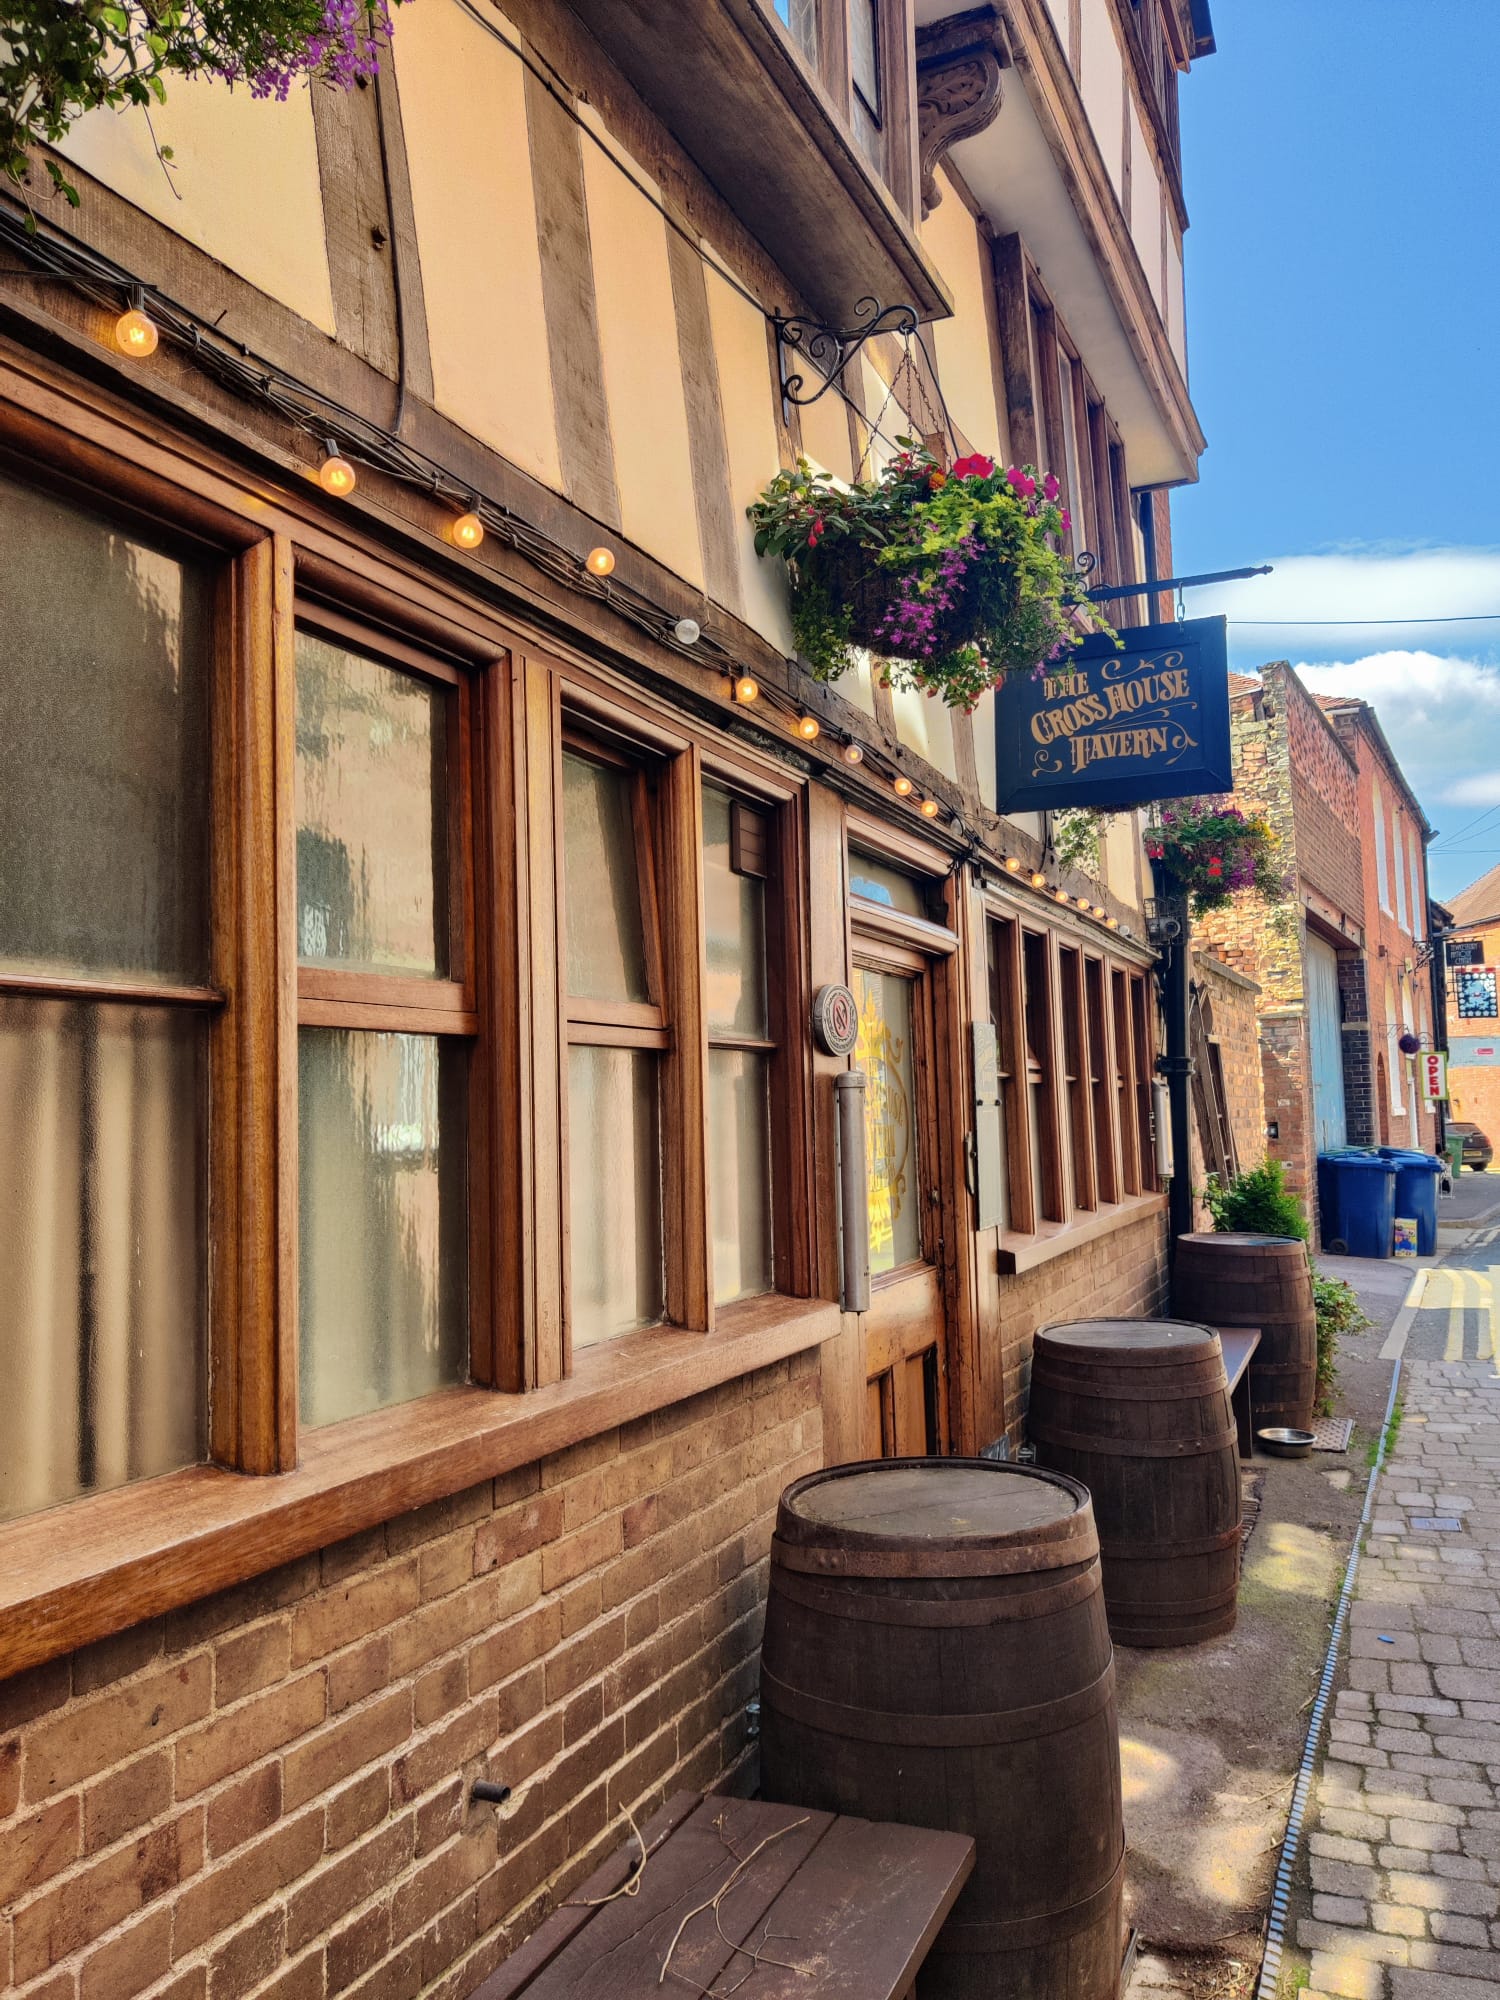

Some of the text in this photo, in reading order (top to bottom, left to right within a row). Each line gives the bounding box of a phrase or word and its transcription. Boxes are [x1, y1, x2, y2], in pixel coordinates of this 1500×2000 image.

[1031, 669, 1190, 745] CROSS HOUSE
[1043, 672, 1089, 701] THE
[1069, 727, 1168, 774] TAVERN
[1427, 1055, 1440, 1096] OPEN
